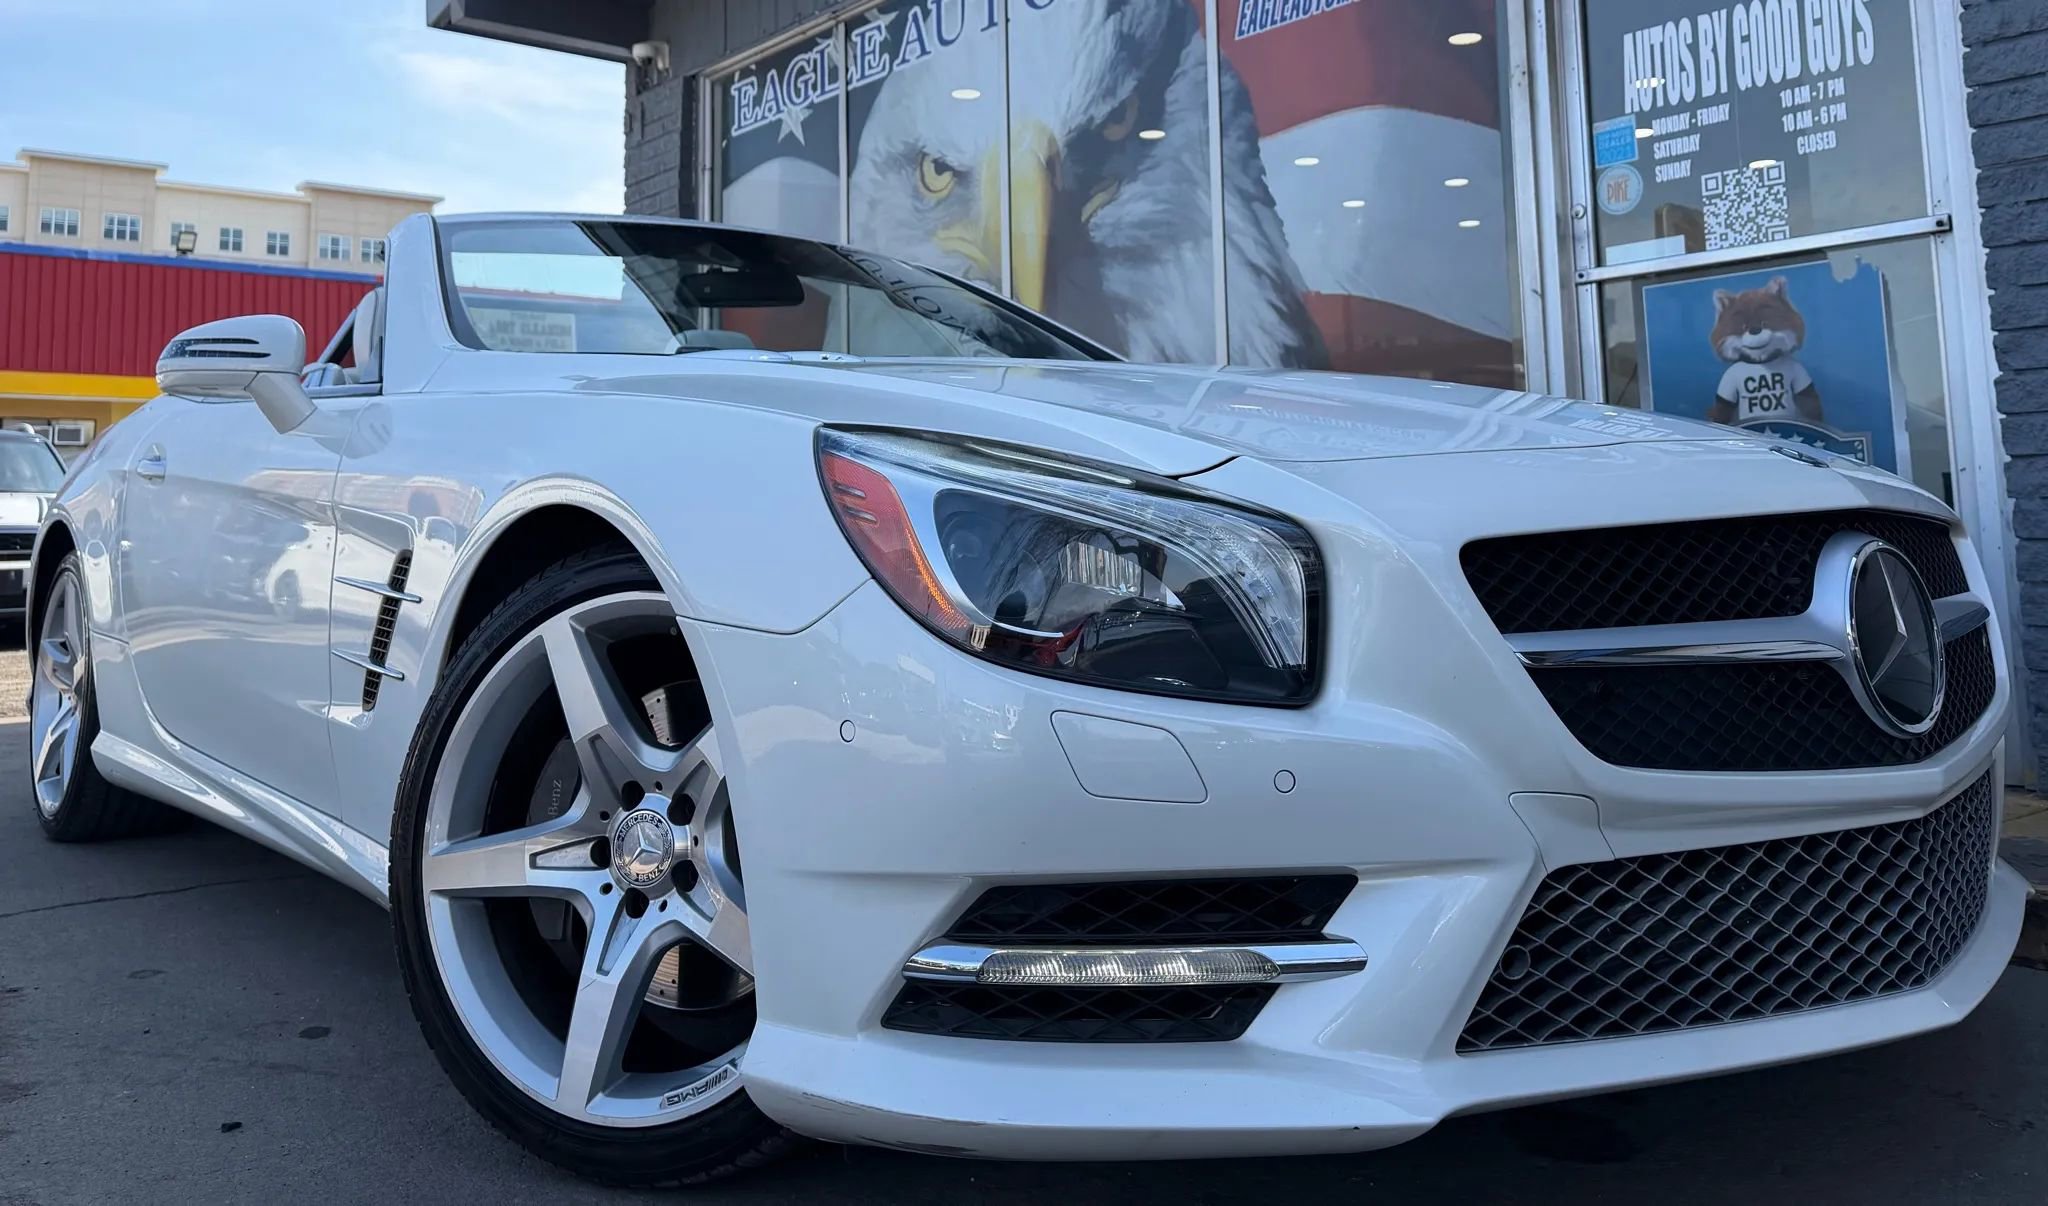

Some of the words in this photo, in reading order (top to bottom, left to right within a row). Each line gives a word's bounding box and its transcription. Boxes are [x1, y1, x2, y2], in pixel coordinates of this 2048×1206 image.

[731, 20, 890, 137] EAGLE
[893, 0, 1053, 71] AU
[1623, 17, 1697, 114] AUTOS
[1697, 8, 1728, 98] BY
[1732, 0, 1802, 91] GOOD
[1803, 0, 1875, 76] GUYS
[1779, 89, 1793, 108] 10
[1793, 84, 1811, 106] AM
[1817, 82, 1824, 100] 7
[1827, 77, 1846, 98] PM
[1651, 112, 1690, 137] MONDAY
[1697, 102, 1730, 127] FRIDAY
[1781, 113, 1795, 133] 10
[1796, 109, 1813, 131] AM
[1820, 106, 1828, 124] 6
[1829, 102, 1847, 123] PM
[1653, 133, 1701, 160] SATURDAY
[1796, 130, 1837, 156] CLOSED
[1655, 159, 1692, 184] SUNDAY
[1744, 372, 1785, 394] CAR
[1748, 393, 1786, 414] FOX
[548, 779, 562, 816] Benz
[620, 813, 660, 838] MERCEDES
[638, 867, 660, 882] BENZ
[666, 1080, 709, 1107] AMG
